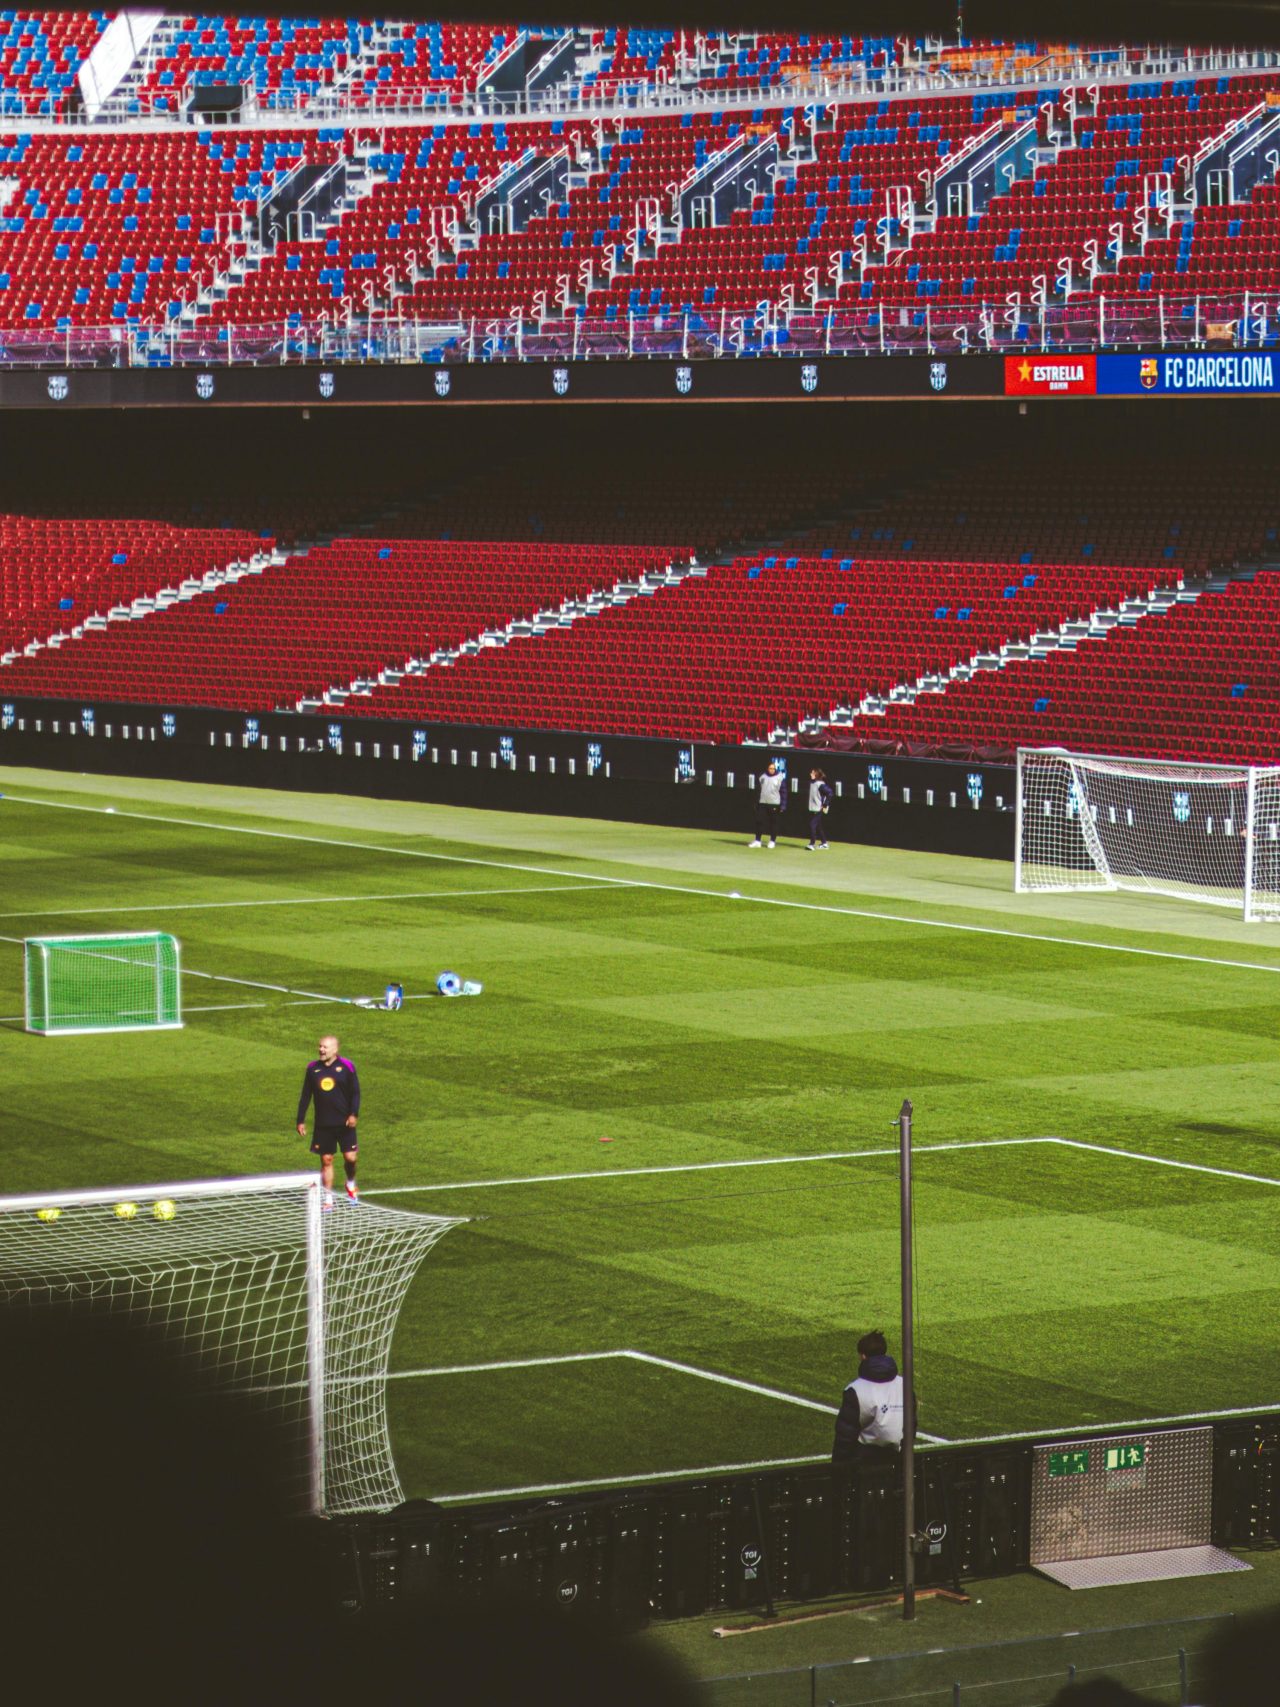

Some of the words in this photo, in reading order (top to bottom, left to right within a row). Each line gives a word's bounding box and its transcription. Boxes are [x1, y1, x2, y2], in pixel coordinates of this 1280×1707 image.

[1033, 364, 1084, 382] ESTRELLA
[1165, 357, 1183, 388] FC
[1186, 356, 1273, 387] BARCELONA
[930, 1527, 941, 1536] TGI
[745, 1551, 757, 1559] TGI
[561, 1588, 573, 1597] TGI
